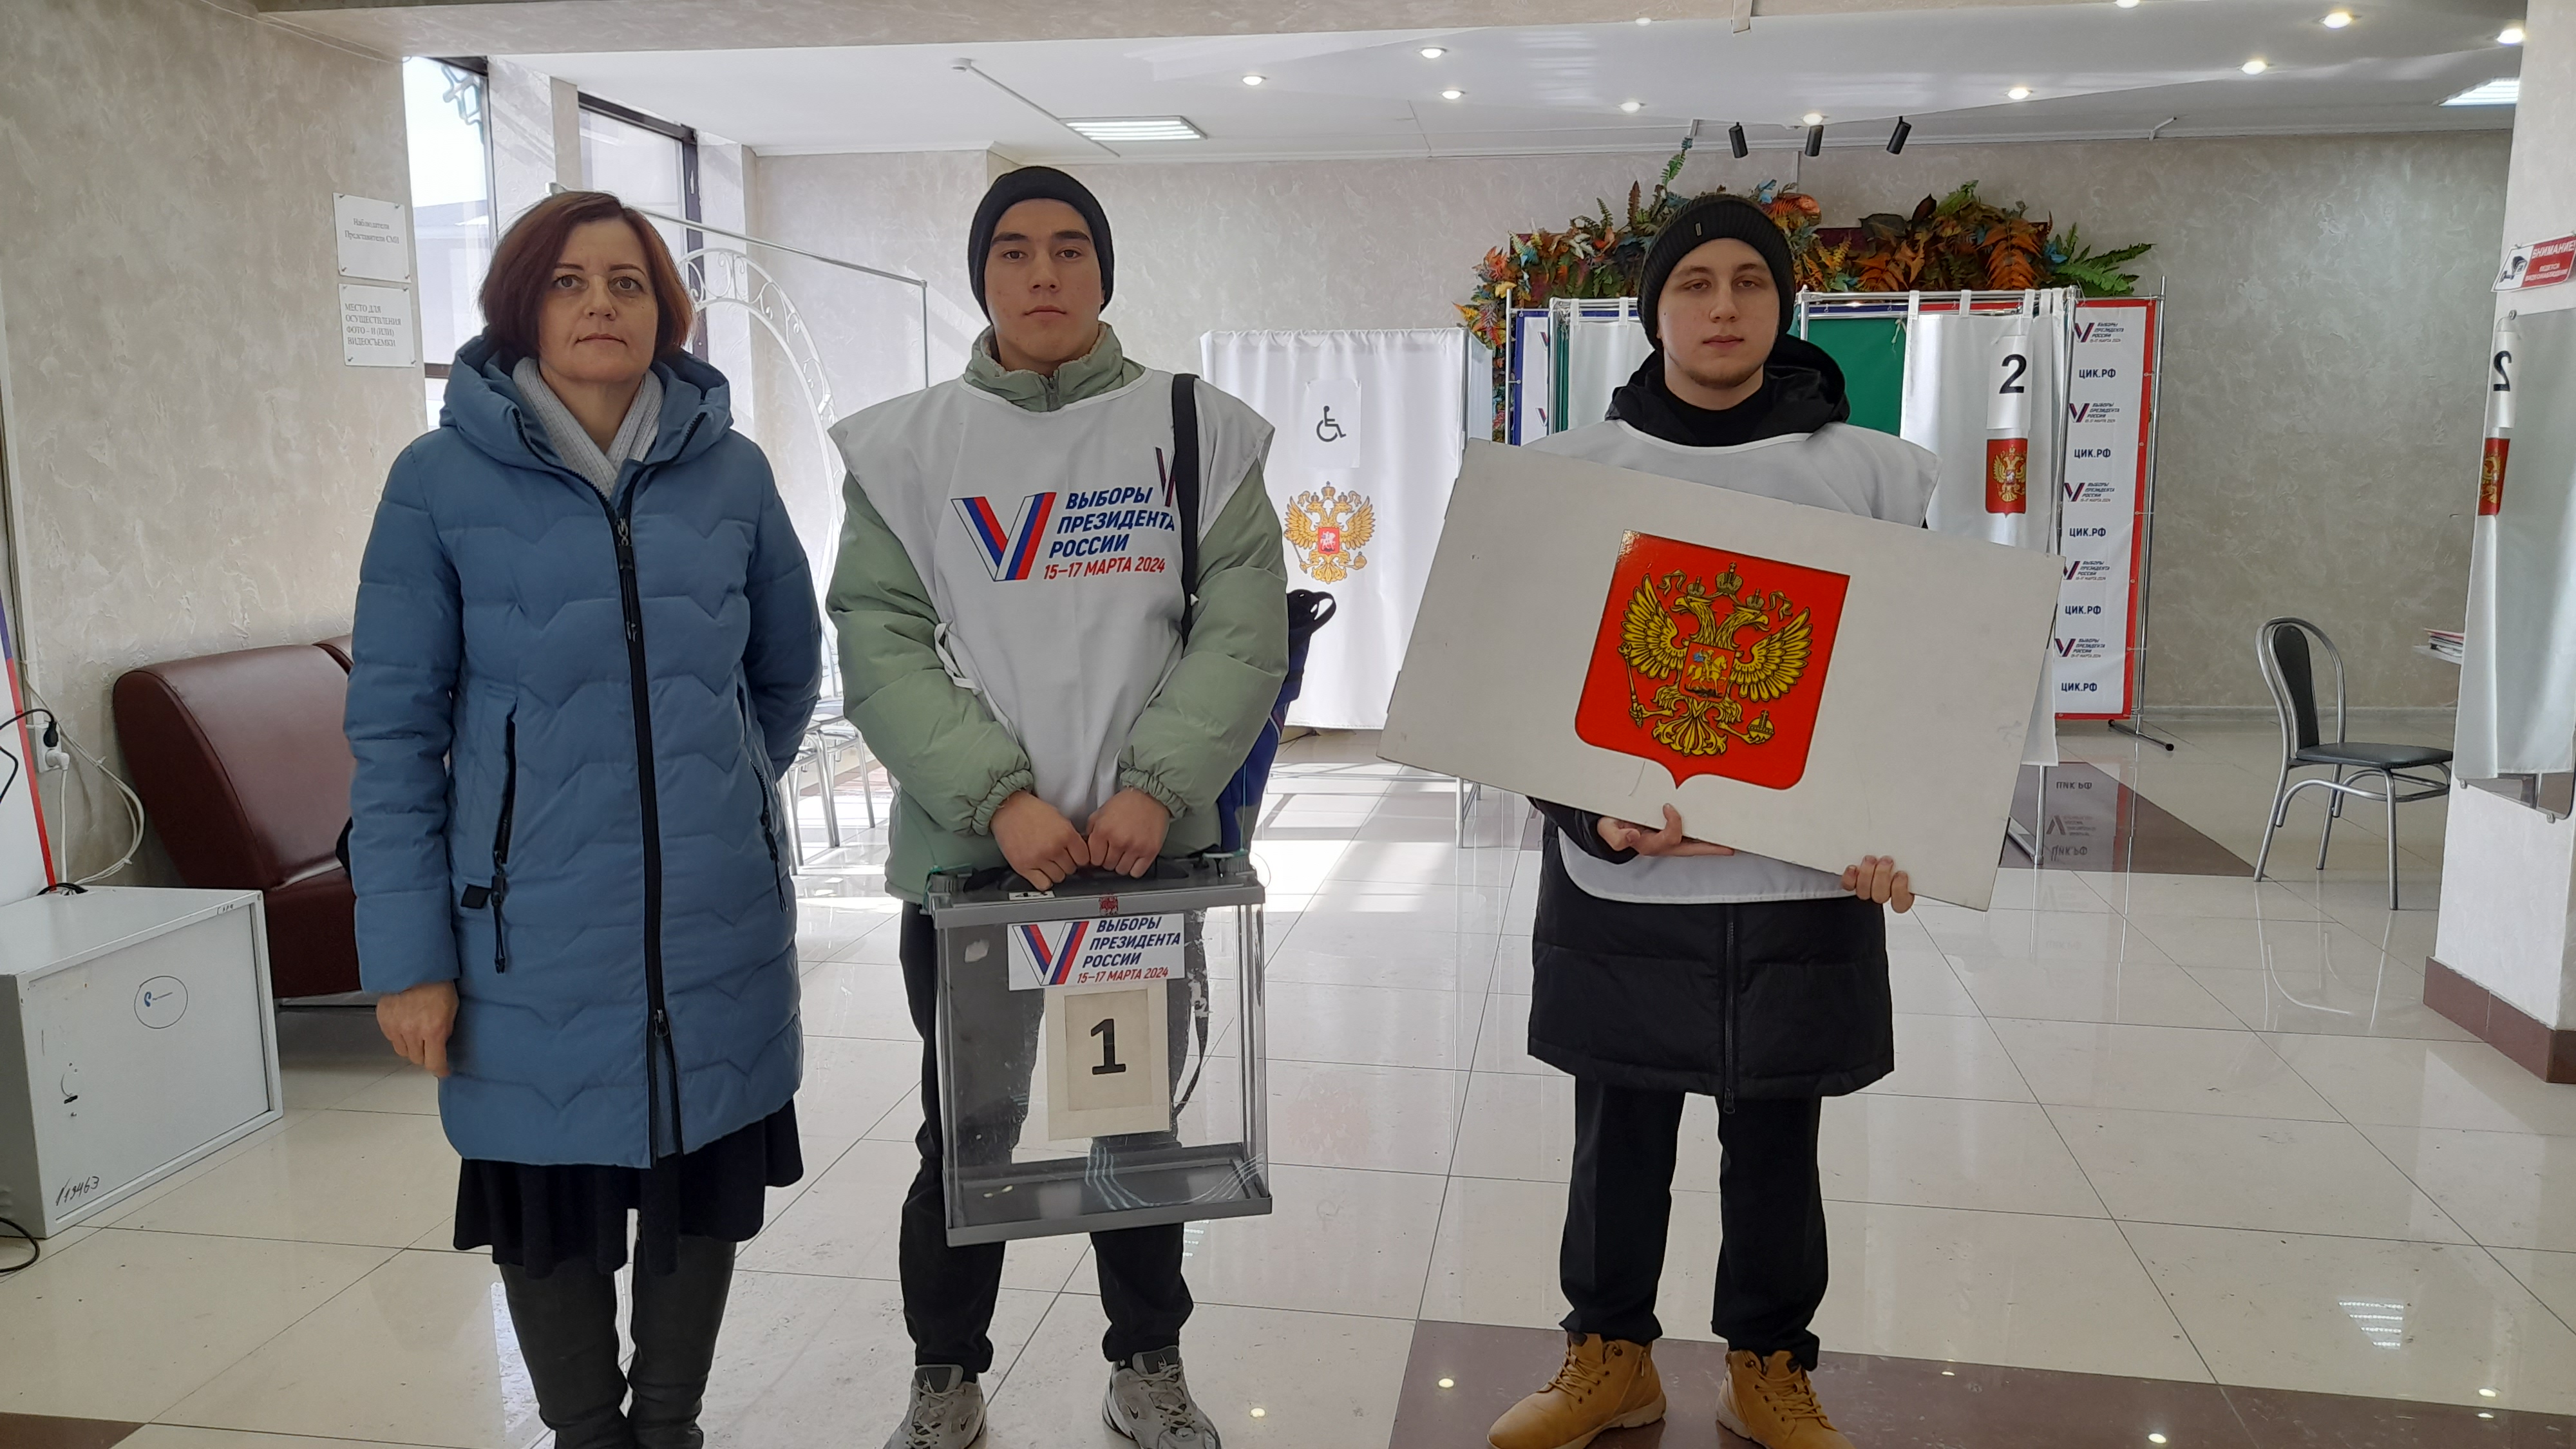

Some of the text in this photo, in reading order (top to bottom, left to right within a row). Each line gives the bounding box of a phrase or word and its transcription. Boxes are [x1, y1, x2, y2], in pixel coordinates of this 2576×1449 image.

[345, 303, 381, 314] МЕСТО ДЛЯ
[345, 314, 401, 325] ОСУЩЕСТВЛЕНИЯ
[346, 326, 366, 334] ФОТО
[347, 337, 396, 346] ВИДЕОСЪЕМКИ
[1999, 354, 2027, 394] 2
[2079, 368, 2116, 379] ЦИК.РФ
[2074, 448, 2111, 459] ЦИК.РФ
[1065, 486, 1153, 510] ВЫБОРЫ
[1056, 509, 1175, 535] ПРЕЗИДЕНТА
[2069, 527, 2107, 537] ЦИК.РФ
[1048, 534, 1130, 559] РОССИИ
[1084, 557, 1132, 578] МАРТА
[1134, 556, 1166, 574] 2024
[2065, 605, 2101, 615] ЦИК.РФ
[2061, 683, 2098, 692] ЦИК.РФ
[1095, 916, 1162, 933] ВЫБОРЫ
[1088, 932, 1181, 951] ПРЕЗИДЕНТА
[1082, 952, 1142, 969] РОССИИ
[1106, 969, 1141, 981] МАРТА
[1142, 967, 1169, 979] 2024
[1090, 1018, 1126, 1075] 1
